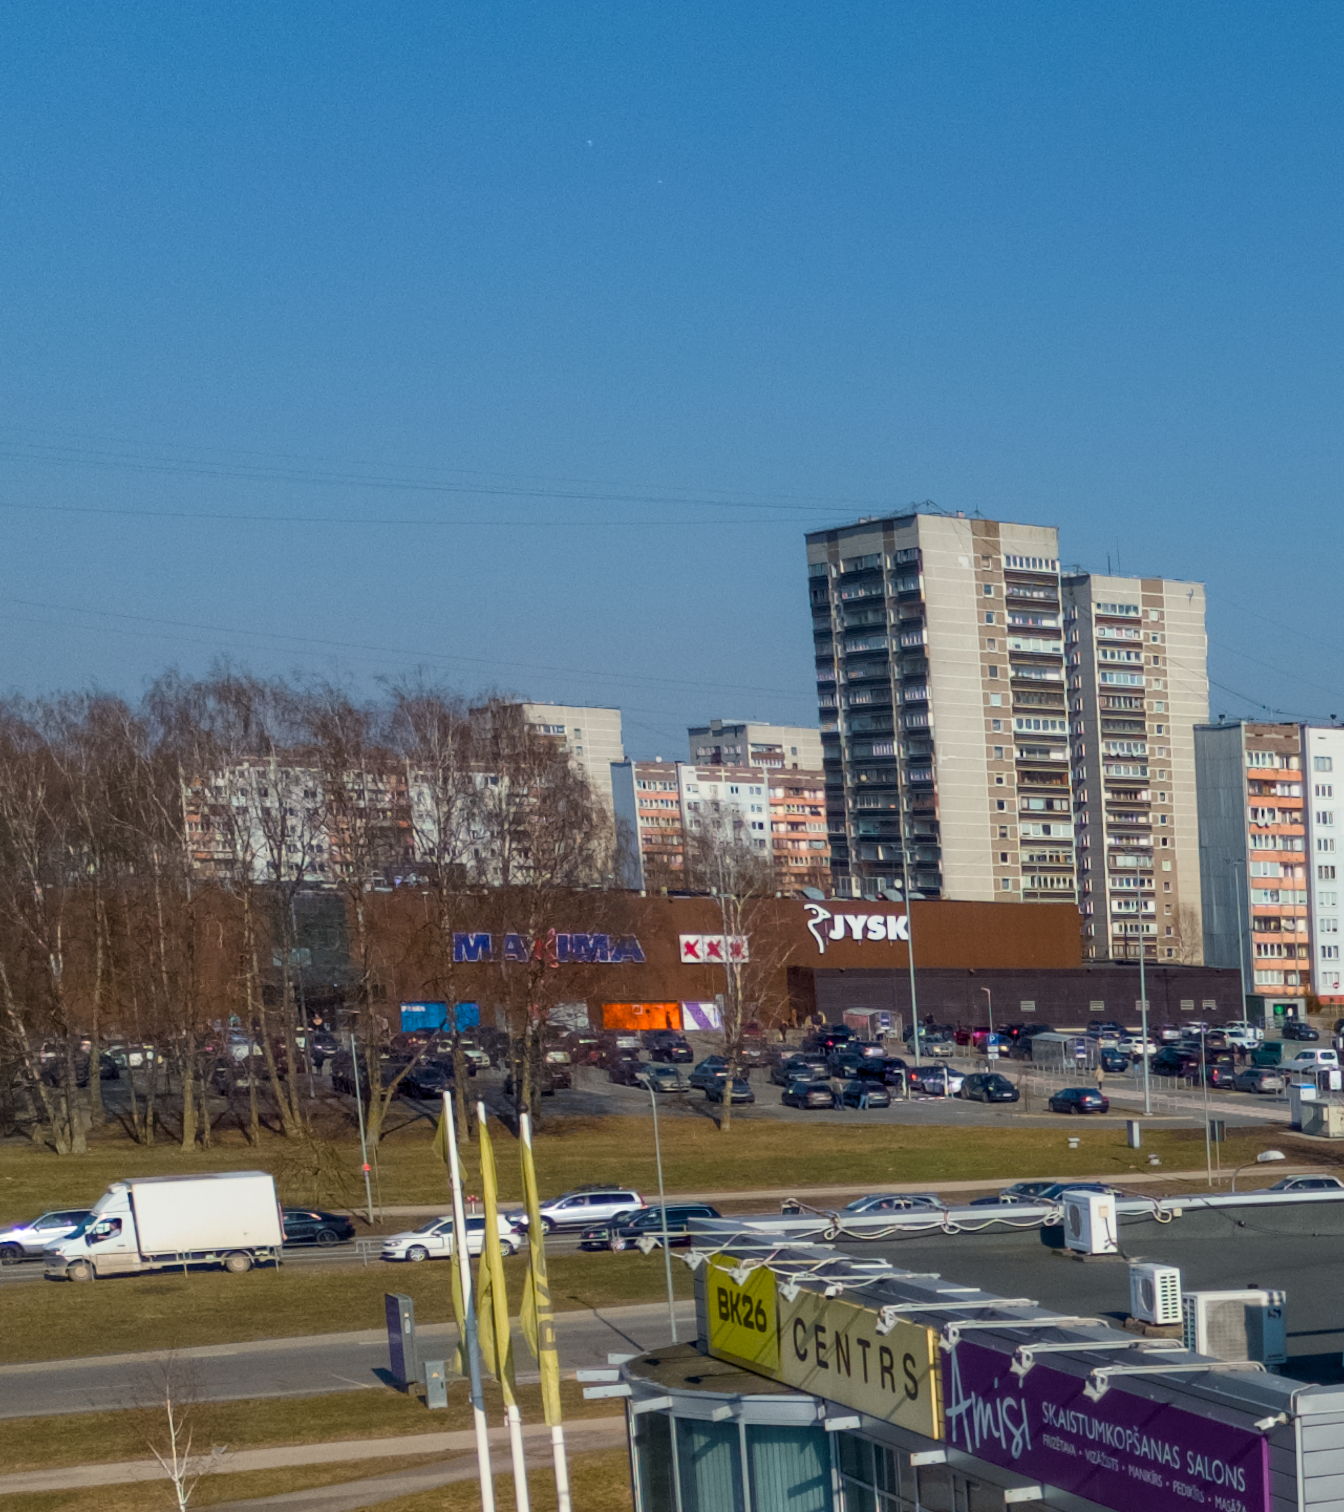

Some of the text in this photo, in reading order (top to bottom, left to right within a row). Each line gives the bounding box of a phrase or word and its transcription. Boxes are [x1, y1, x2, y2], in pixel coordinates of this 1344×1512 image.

[829, 914, 908, 941] JYSK
[716, 1287, 769, 1334] BK26
[793, 1316, 920, 1401] CENTRS
[945, 1351, 1032, 1459] Amisi
[1042, 1401, 1247, 1493] SKAISTUMKOPŠANAS SALONS
